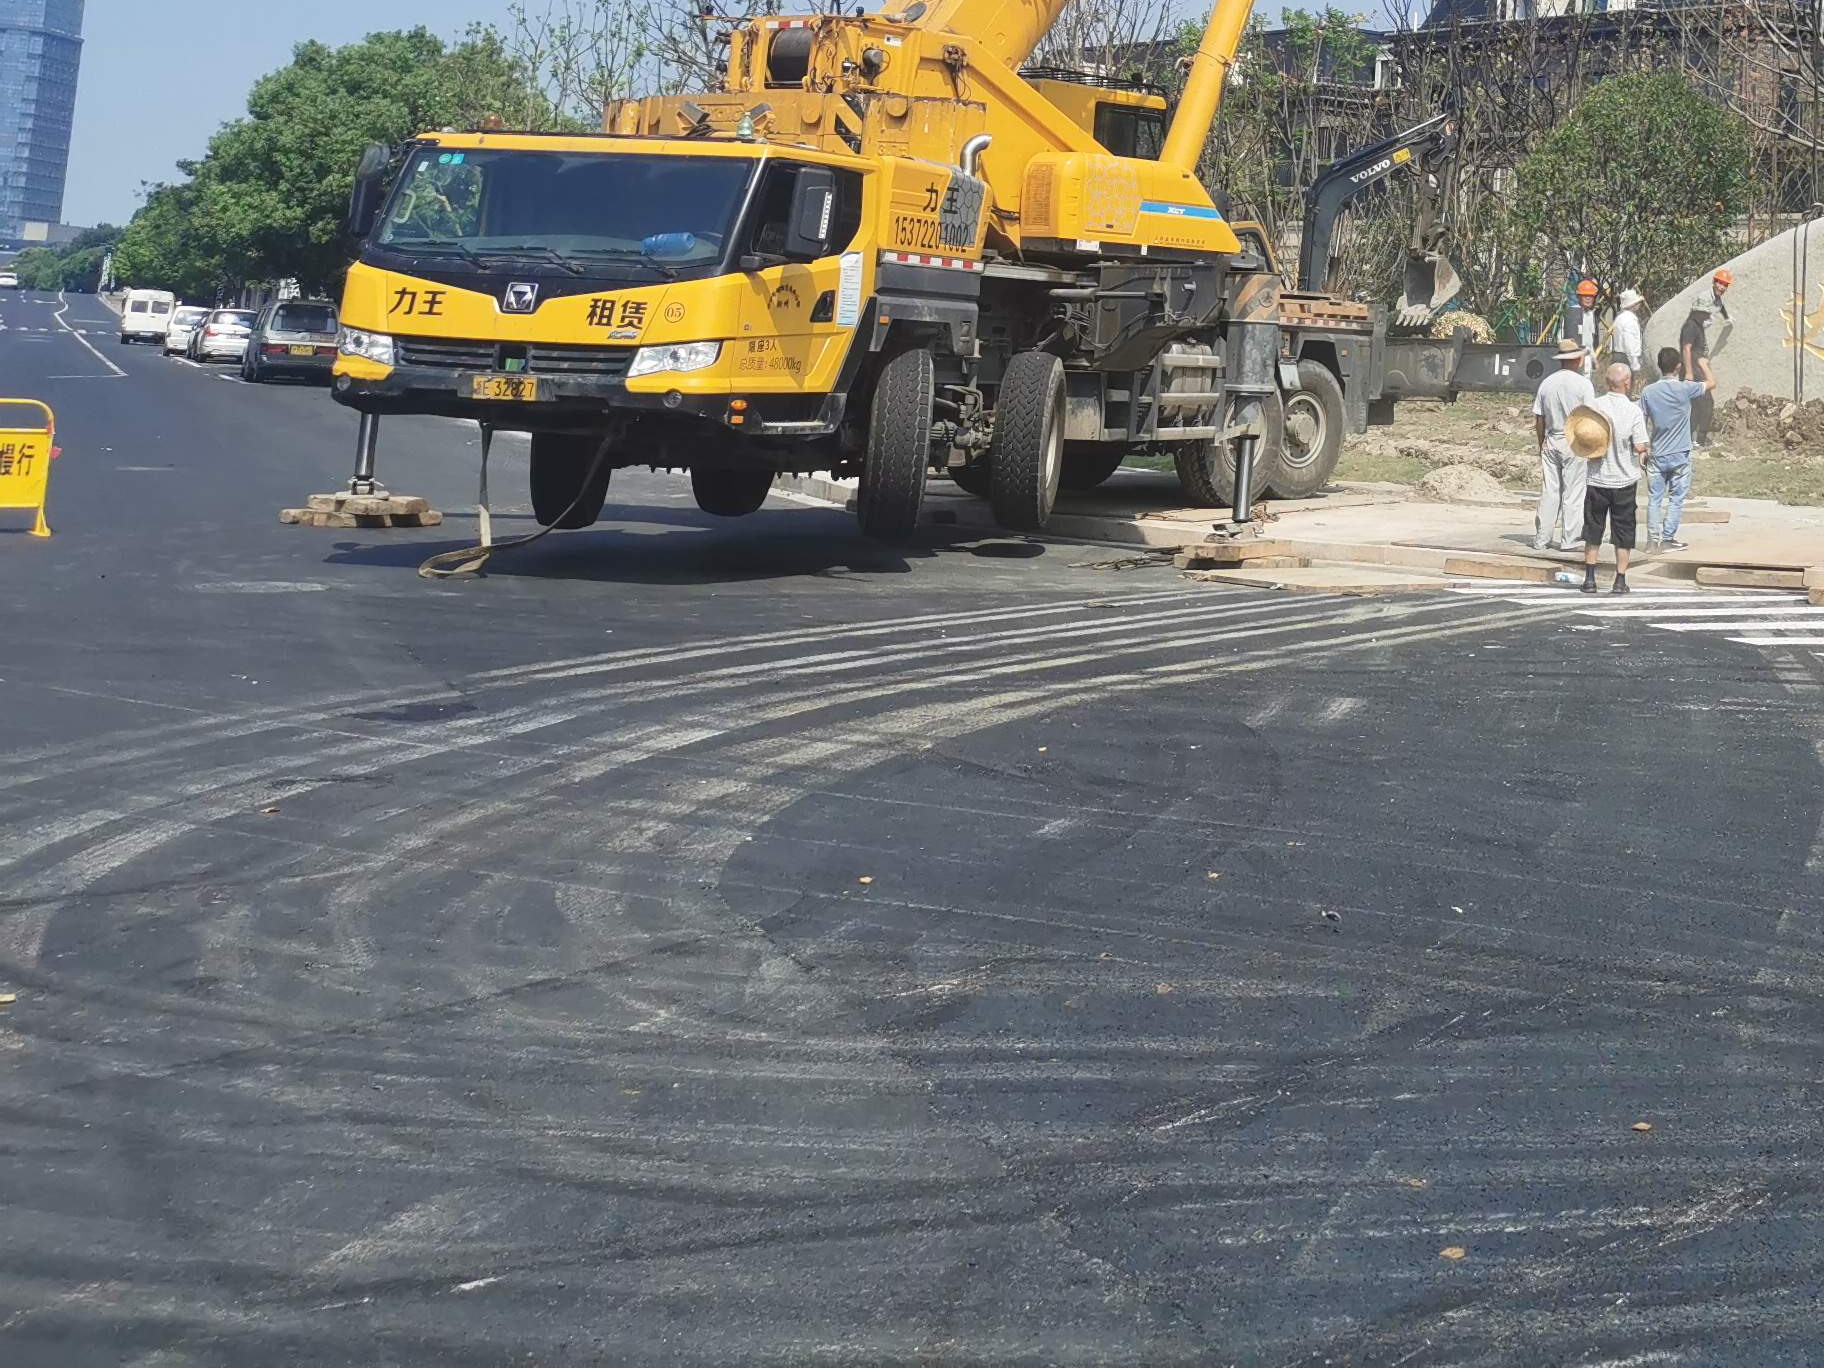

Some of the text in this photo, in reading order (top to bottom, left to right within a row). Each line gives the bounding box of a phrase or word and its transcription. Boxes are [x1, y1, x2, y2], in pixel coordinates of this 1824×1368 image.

[1350, 159, 1391, 183] VOLVO
[923, 182, 960, 215] 力王
[388, 287, 447, 316] 力王
[586, 297, 648, 330] 租赁
